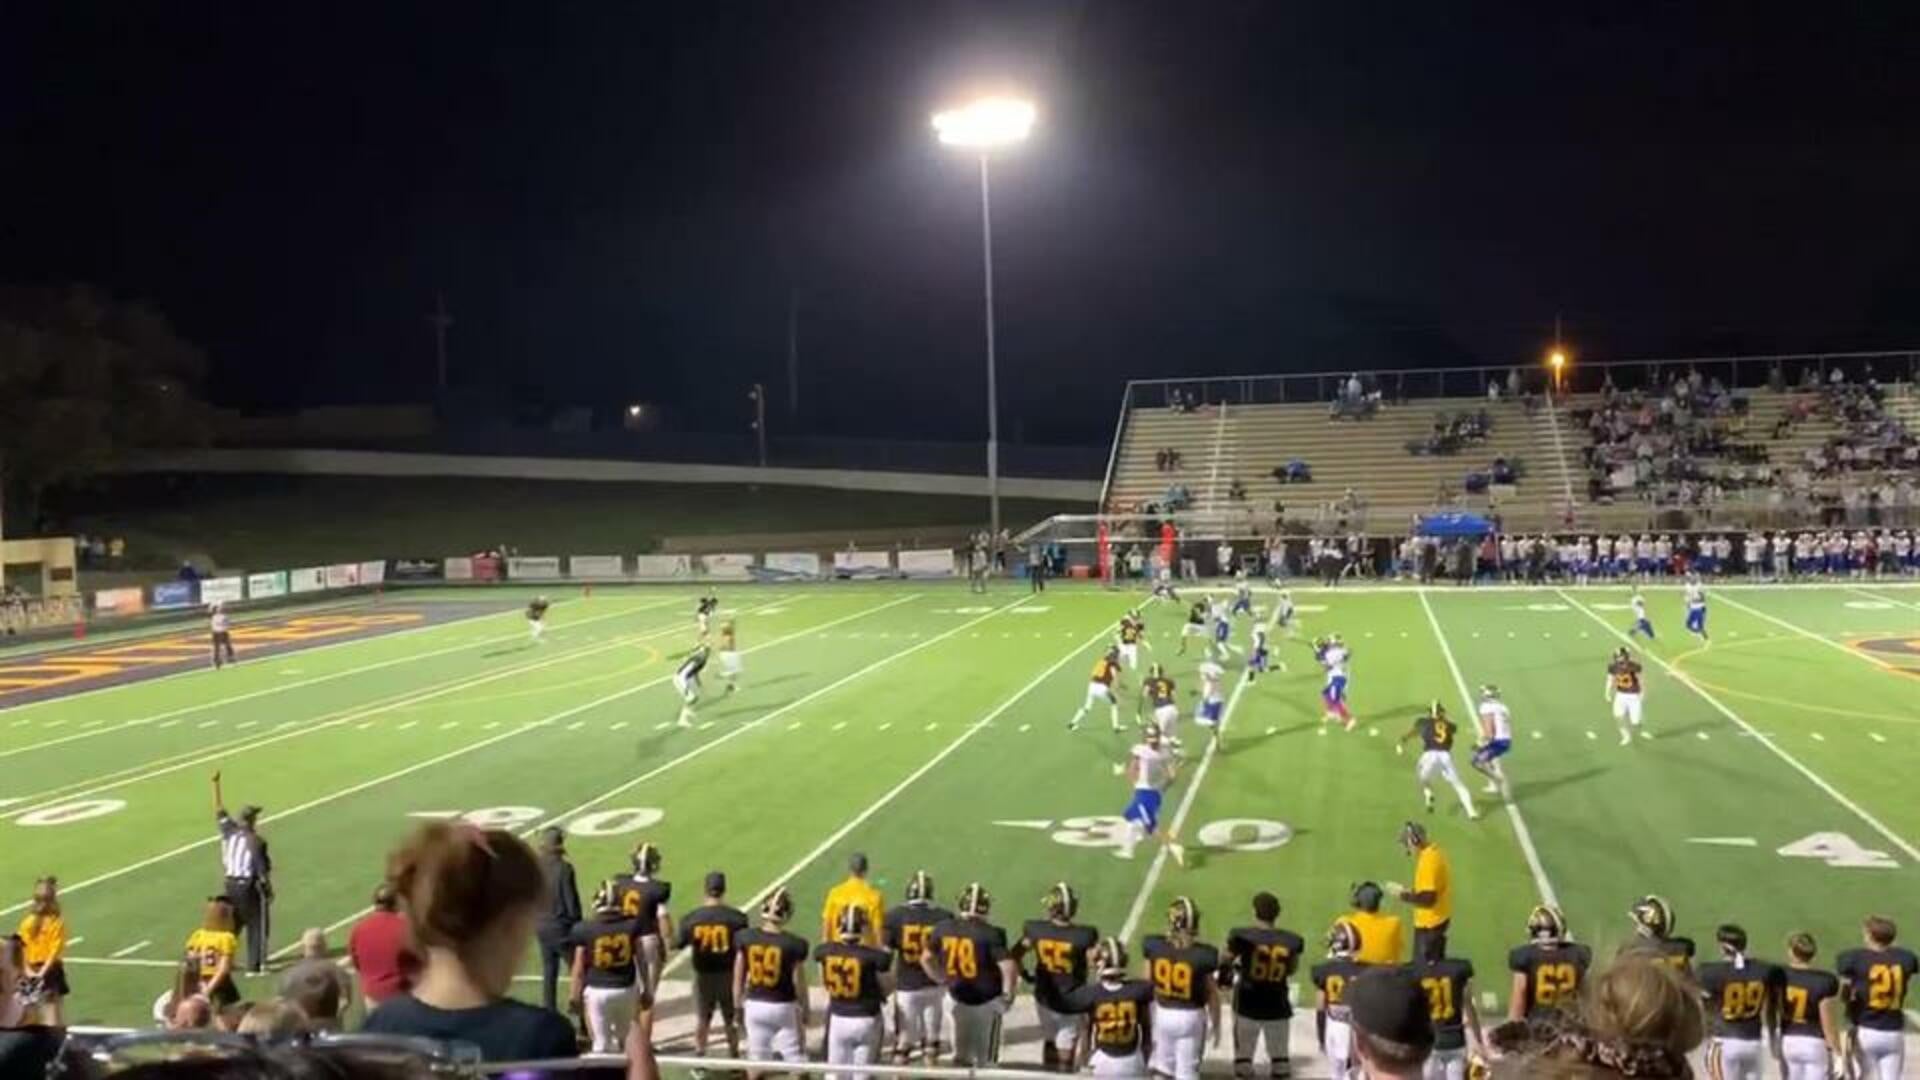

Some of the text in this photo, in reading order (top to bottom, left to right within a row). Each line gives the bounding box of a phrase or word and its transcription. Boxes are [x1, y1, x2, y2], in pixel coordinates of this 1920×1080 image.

[693, 924, 731, 954] 70
[942, 935, 977, 978] 78
[1037, 939, 1073, 975] 55
[748, 943, 782, 985] 69
[825, 955, 862, 998] 53
[1155, 956, 1191, 999] 99
[1250, 943, 1289, 982] 66
[1786, 985, 1808, 1023] 7
[1868, 963, 1904, 1010] 21
[1096, 1000, 1137, 1045] 20
